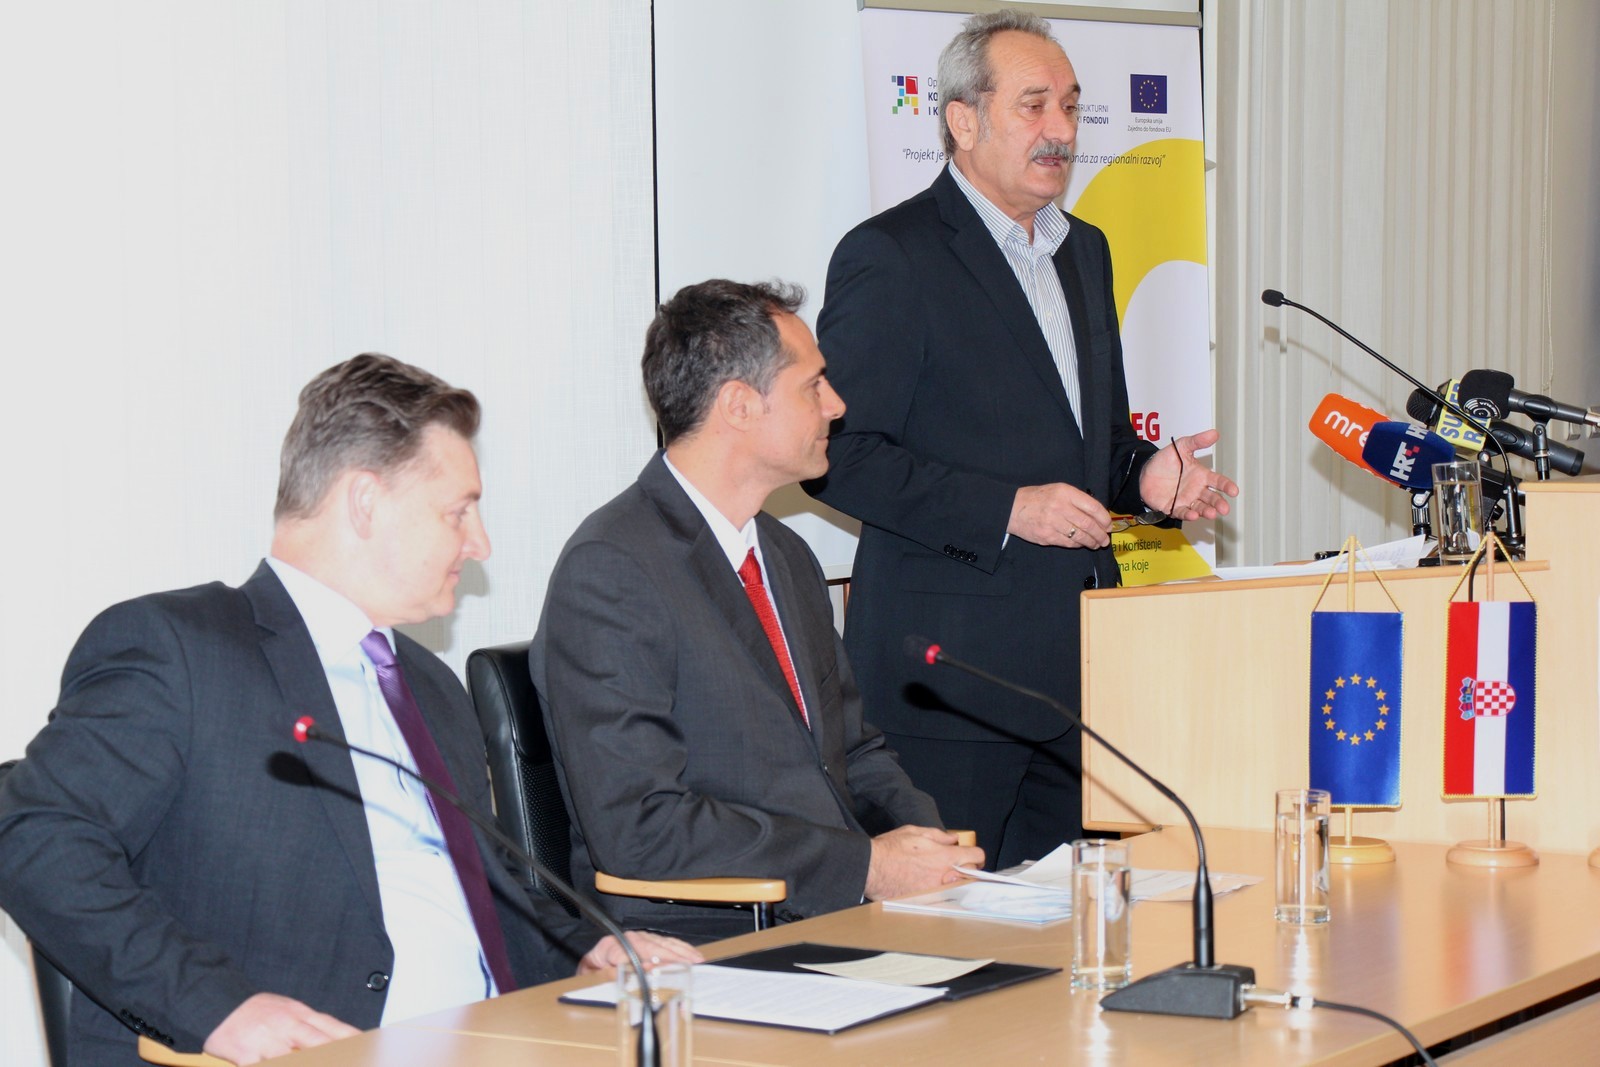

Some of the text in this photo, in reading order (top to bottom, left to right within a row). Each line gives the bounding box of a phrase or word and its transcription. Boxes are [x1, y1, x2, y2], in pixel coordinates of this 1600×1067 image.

[1083, 116, 1109, 124] FONDOVI
[936, 150, 944, 163] je
[1090, 155, 1098, 164] za
[1100, 153, 1139, 167] regionalni
[1389, 441, 1418, 481] HRT
[1122, 537, 1162, 552] korištenje
[1131, 559, 1149, 574] koje
